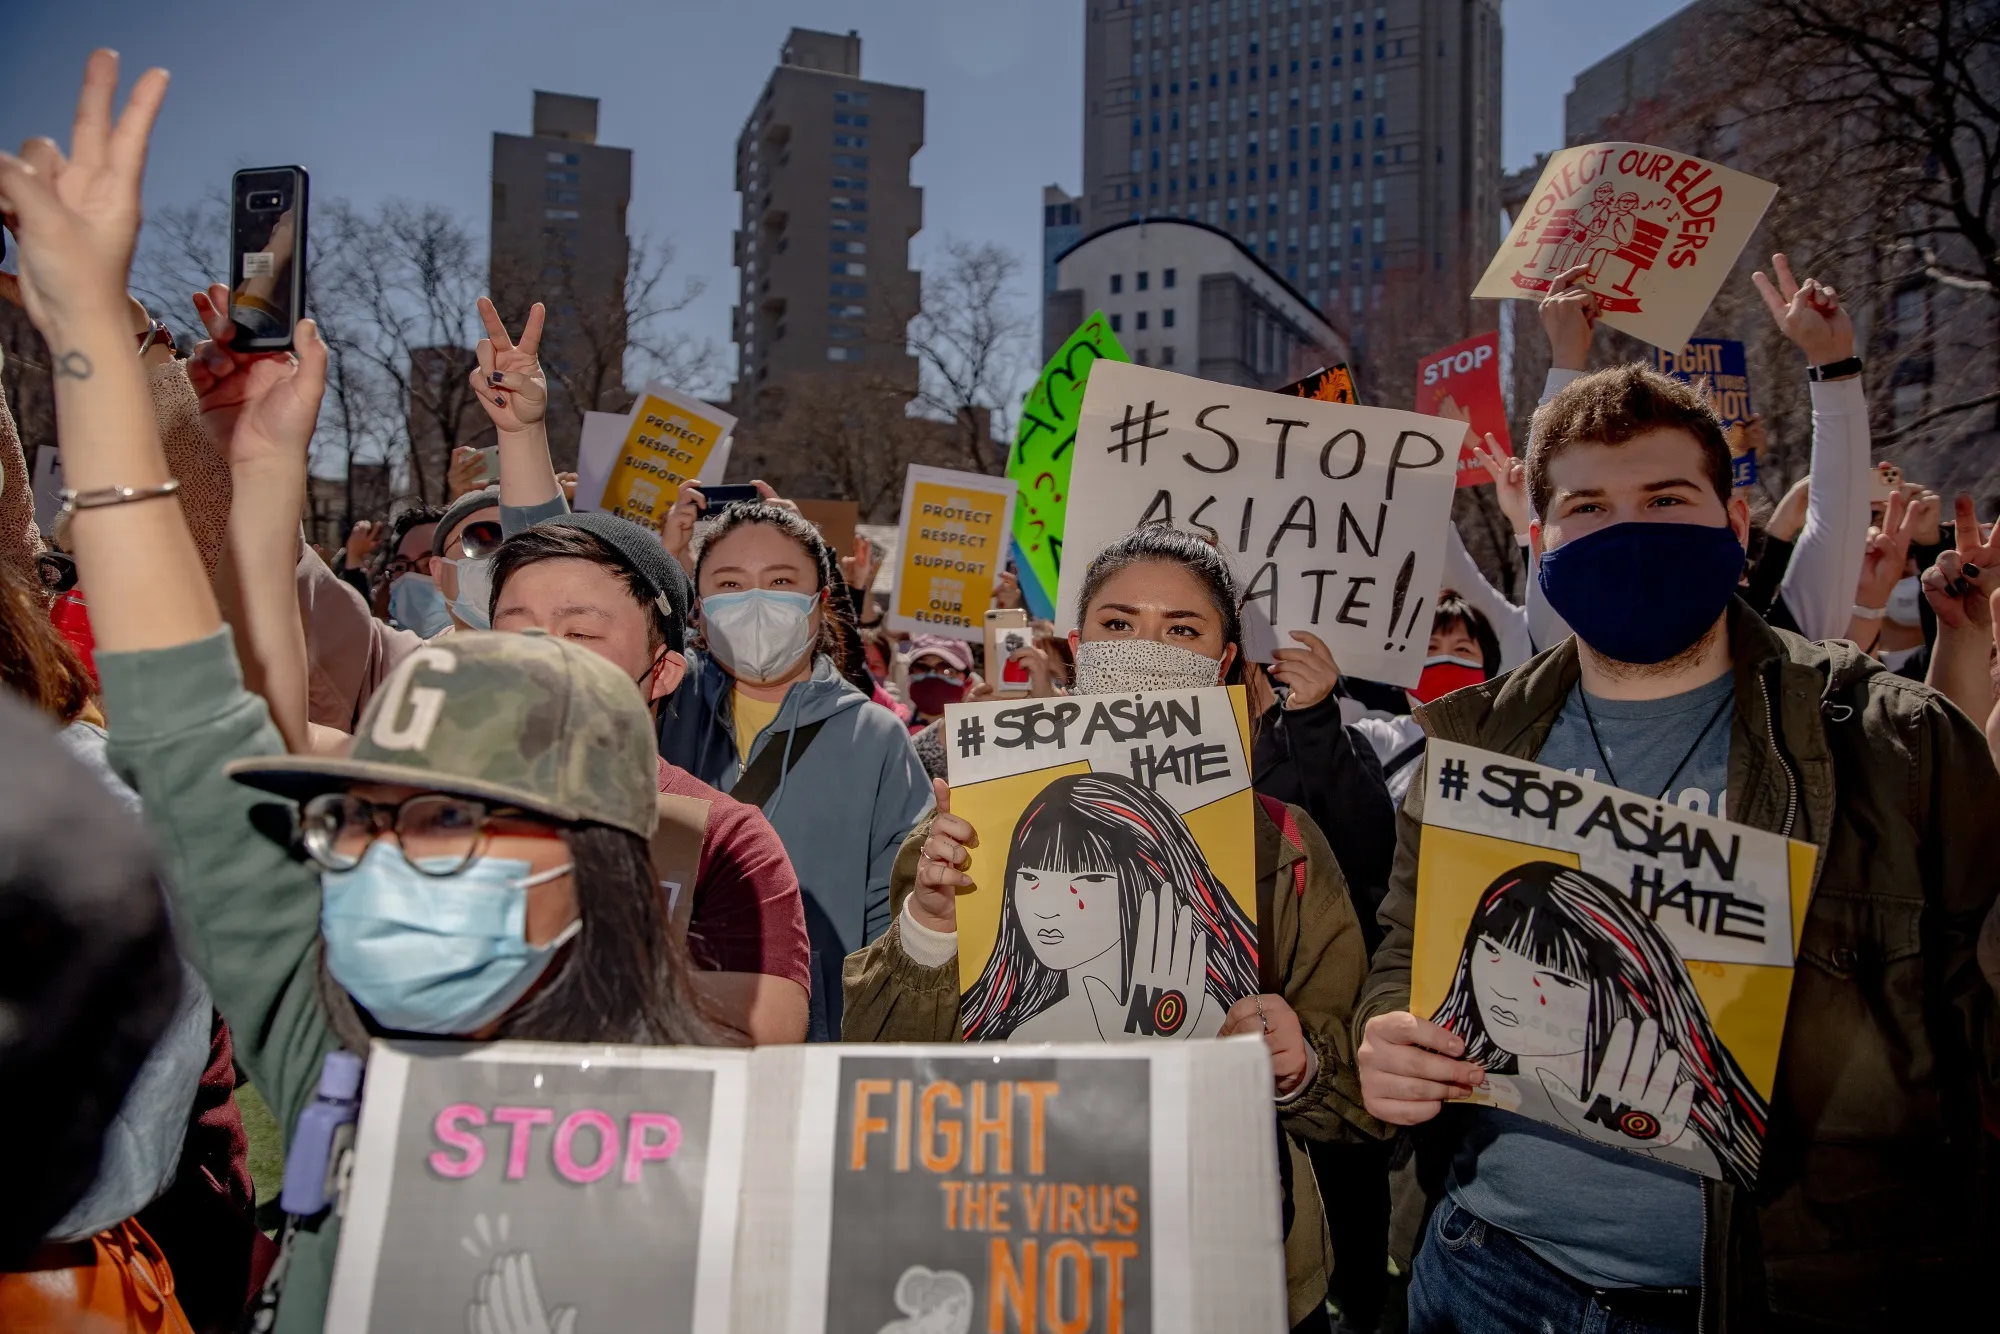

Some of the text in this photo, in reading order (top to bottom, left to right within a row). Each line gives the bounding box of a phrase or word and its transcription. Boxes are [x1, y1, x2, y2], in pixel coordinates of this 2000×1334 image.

[1514, 148, 1723, 270] PROTECT OUR ELDERS
[1423, 345, 1494, 386] STOP
[1657, 343, 1723, 373] FIGHT
[645, 413, 707, 447] PROTECT
[1707, 390, 1750, 421] NOT
[624, 454, 687, 486] SUPPORT
[637, 432, 695, 465] RESPECT
[1106, 400, 1446, 501] #STOP
[613, 505, 658, 531] ELDERS
[627, 497, 655, 516] OUR
[922, 503, 993, 525] PROTECT
[1136, 489, 1389, 559] ASIAN
[920, 527, 988, 549] RESPECT
[913, 554, 986, 576] SUPPORT
[914, 611, 972, 629] ELDERS
[929, 599, 963, 613] OUR
[1236, 550, 1425, 653] ATE!!
[371, 646, 458, 752] G
[1080, 693, 1202, 746] ASIAN
[1129, 742, 1232, 793] HATE
[1574, 795, 1741, 881] ASIAN
[1629, 863, 1766, 945] HATE
[1124, 983, 1188, 1038] NO
[850, 1078, 1061, 1175] FIGHT
[1583, 1093, 1662, 1141] NO
[427, 1101, 684, 1184] STOP
[939, 1180, 1141, 1236] THE VIRUS
[987, 1236, 1140, 1334] NOT
